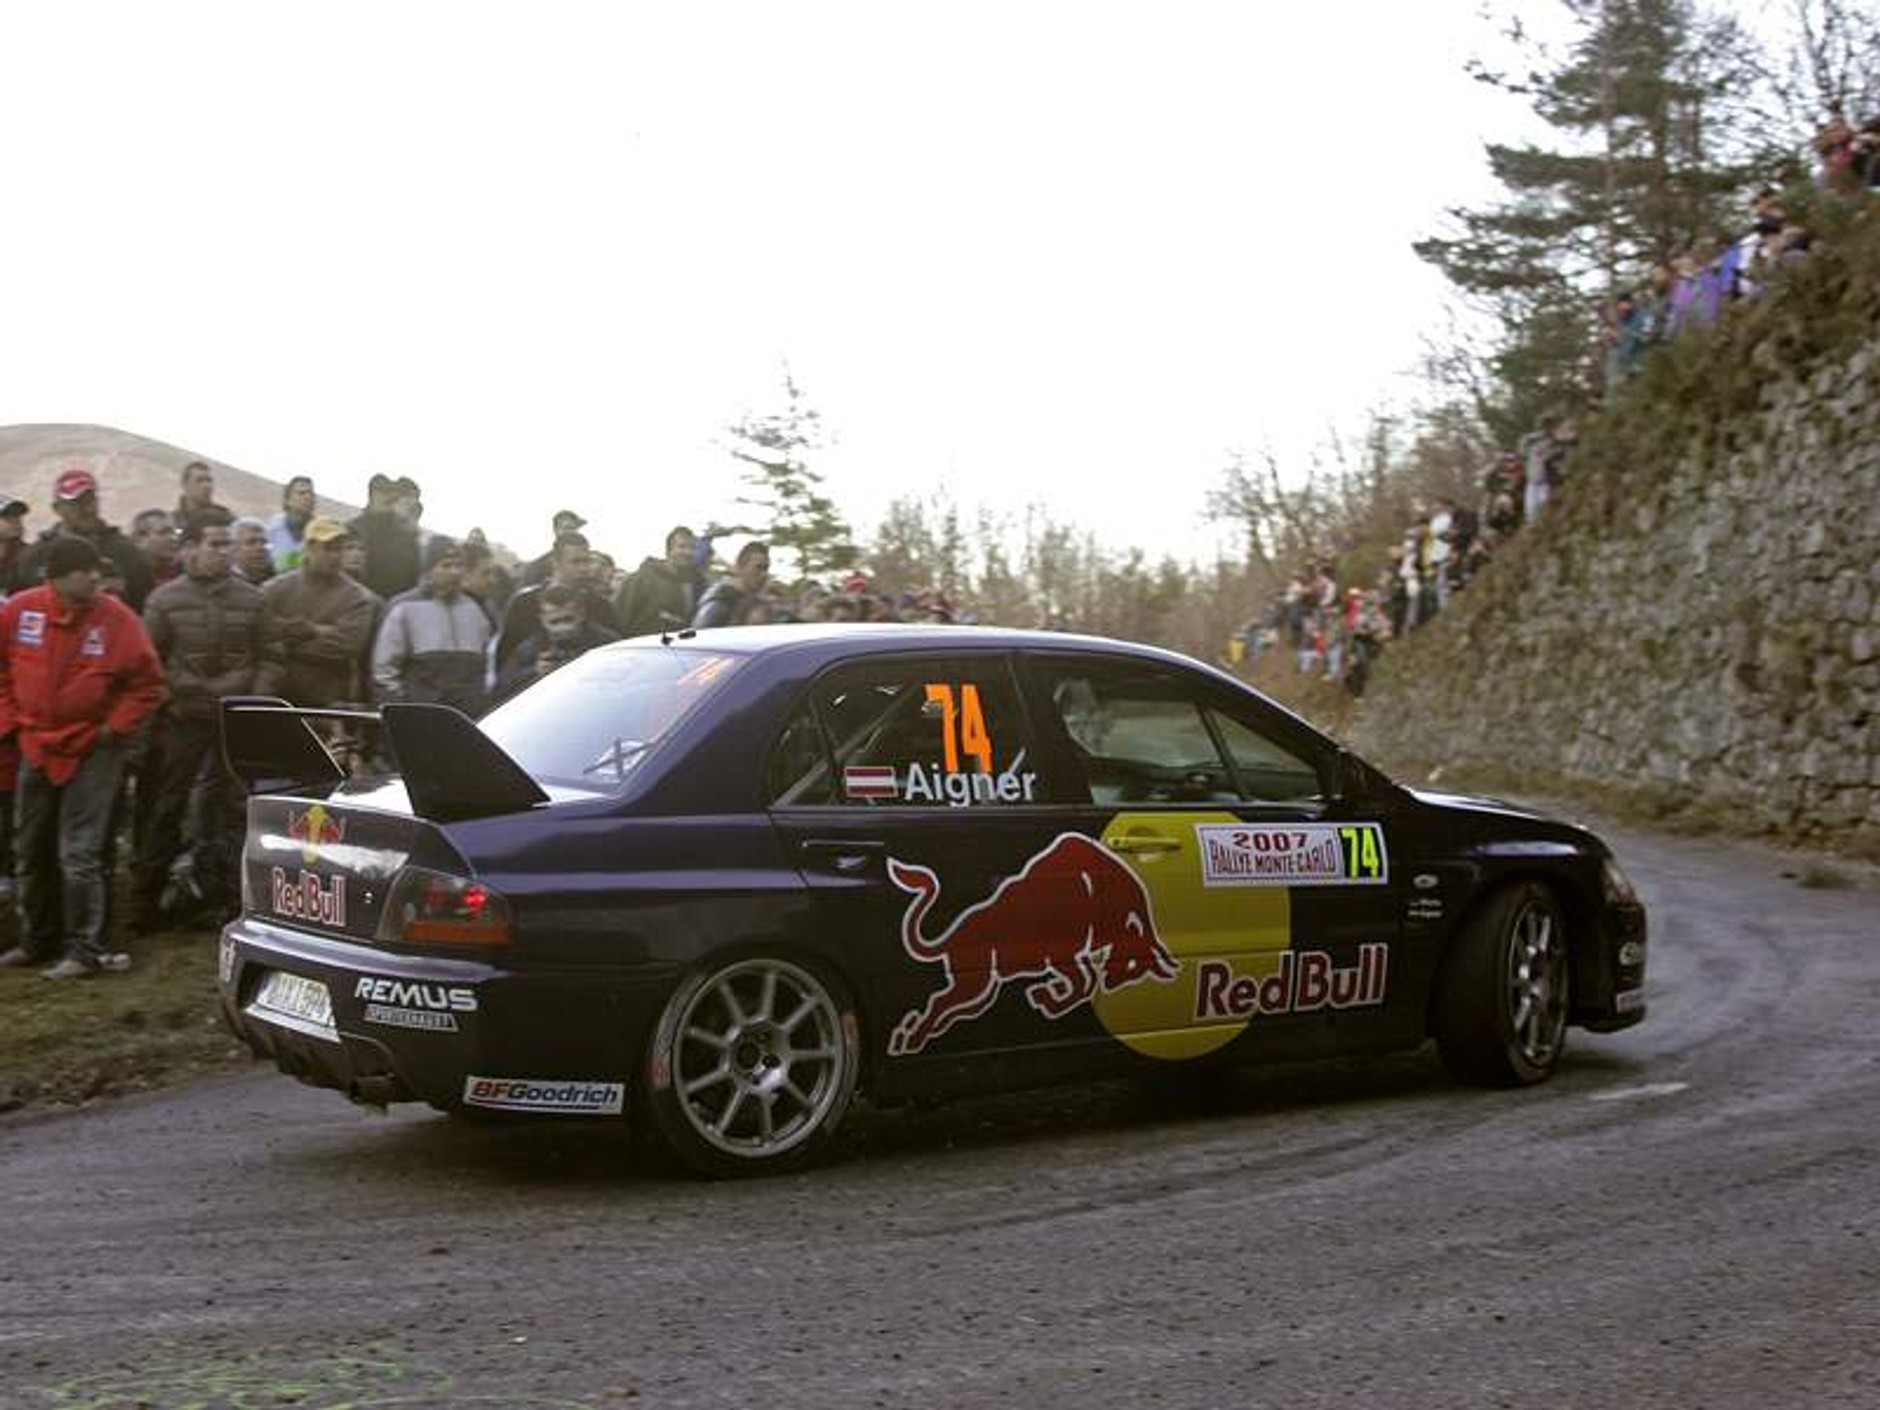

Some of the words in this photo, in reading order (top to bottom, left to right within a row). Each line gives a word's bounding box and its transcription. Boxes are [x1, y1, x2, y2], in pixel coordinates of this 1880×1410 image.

[923, 683, 992, 773] 74
[904, 762, 1036, 808] Aigner
[1208, 839, 1251, 874] RALLYE
[1232, 832, 1308, 852] 2007
[1341, 826, 1379, 879] 74
[272, 866, 306, 919] Red
[301, 871, 346, 927] Bull
[354, 977, 479, 1012] REMUS
[1195, 950, 1294, 1020] Red
[1294, 942, 1389, 1012] Bull
[472, 1081, 617, 1104] BFGoodrich
